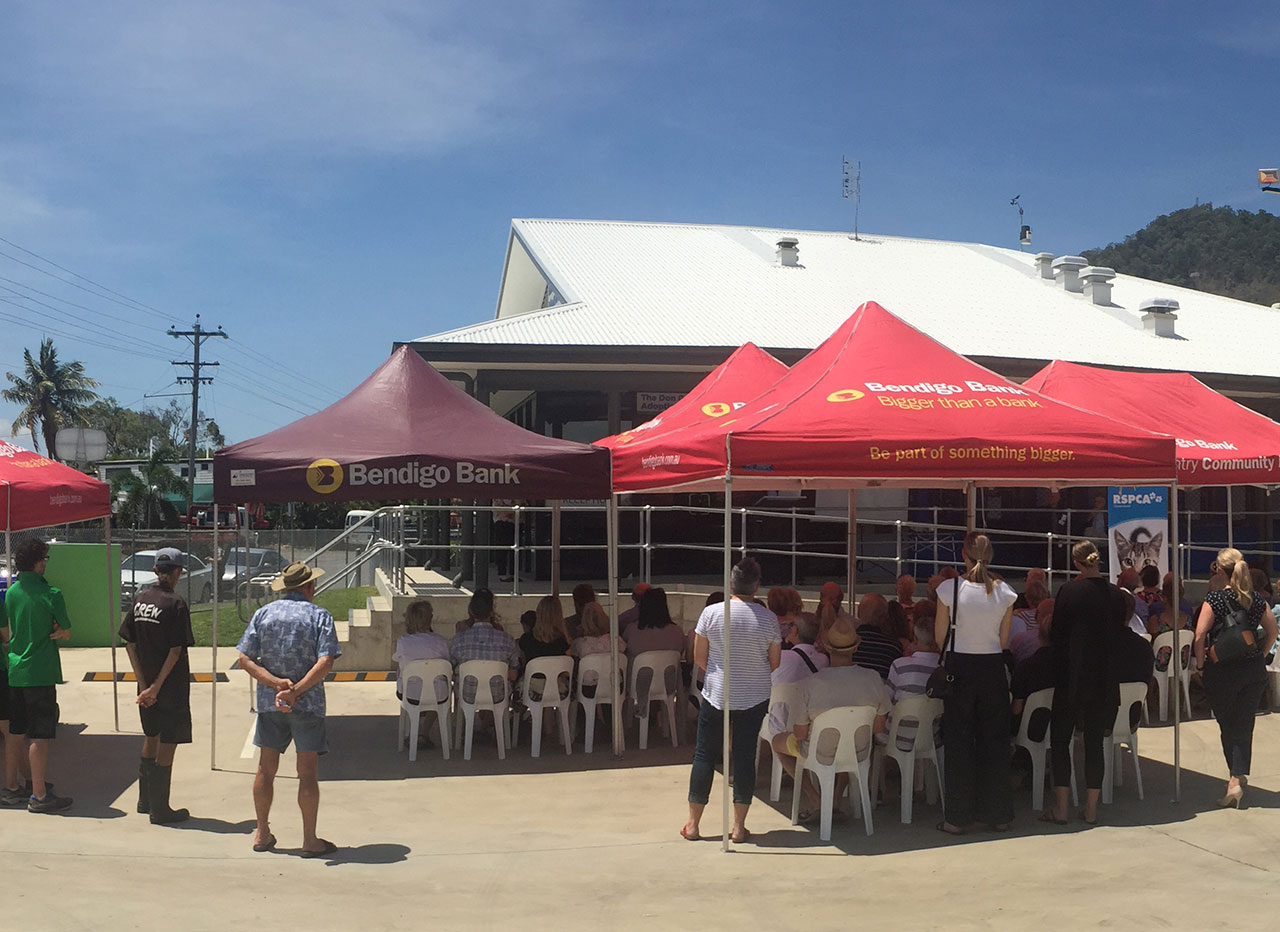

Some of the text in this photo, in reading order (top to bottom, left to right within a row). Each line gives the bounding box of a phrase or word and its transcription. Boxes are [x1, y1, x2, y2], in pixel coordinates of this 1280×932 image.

[864, 380, 1029, 396] Bendigo Bank
[877, 395, 1043, 411] Bigger than a bank
[1195, 440, 1238, 451] Bank
[870, 446, 1076, 463] Be part of something bigger.
[1201, 456, 1275, 472] Community
[349, 462, 521, 489] Bendigo Bank
[1113, 494, 1151, 504] RSPCA
[133, 602, 163, 619] CREW
